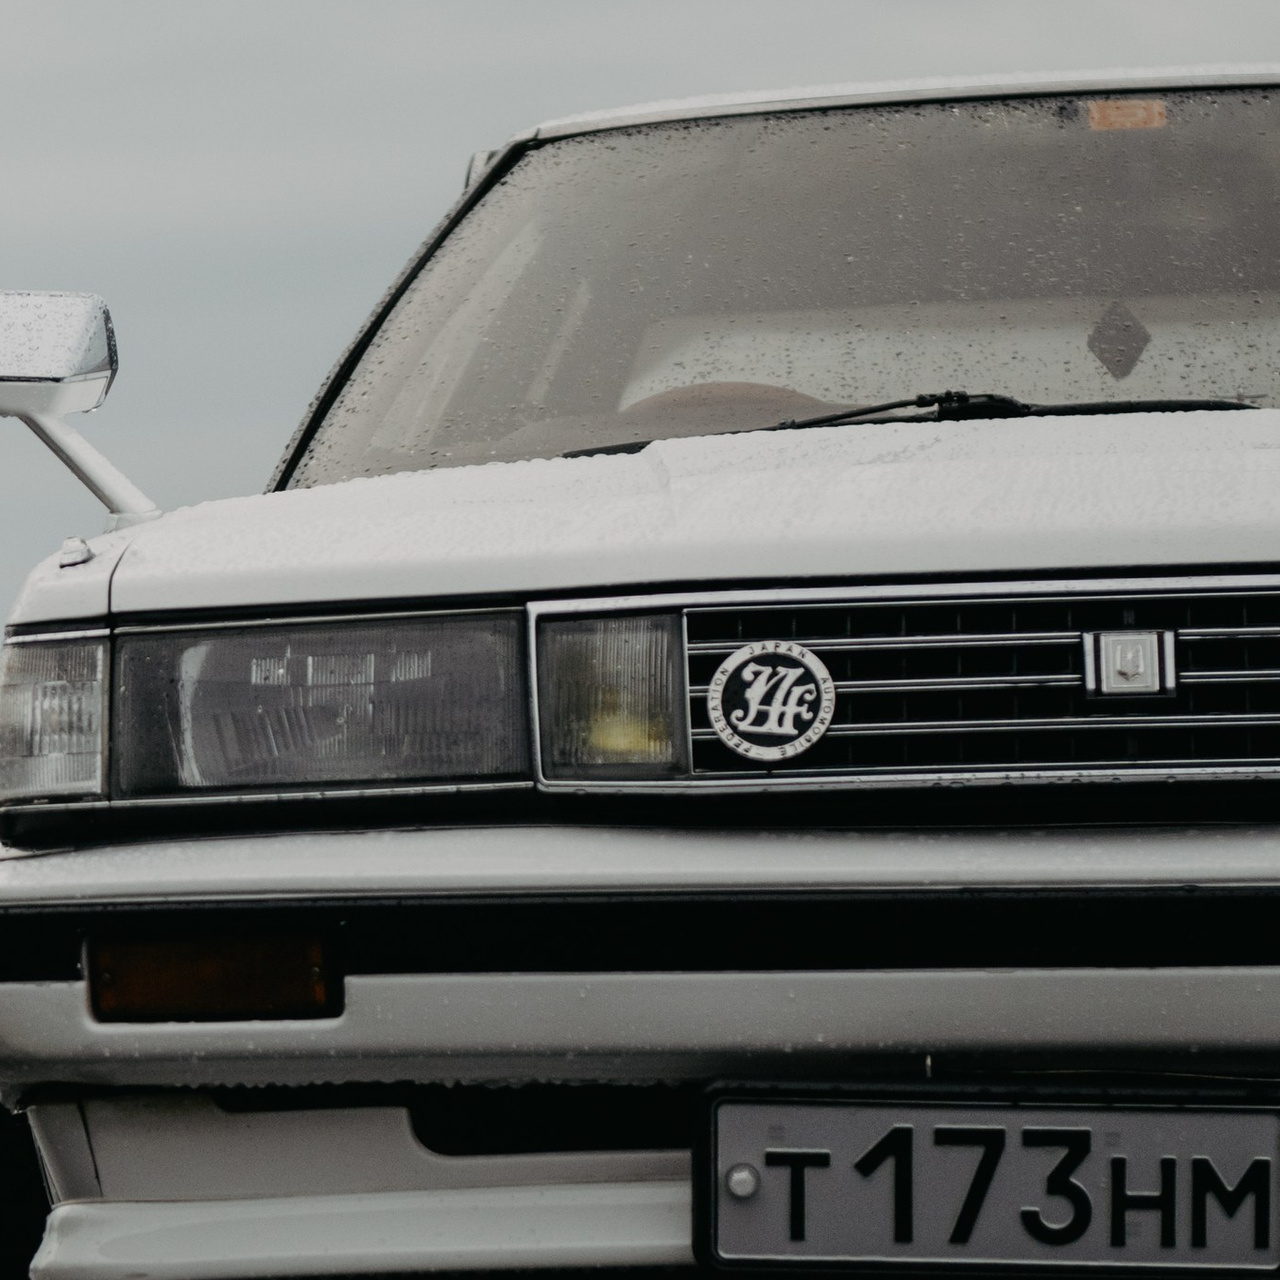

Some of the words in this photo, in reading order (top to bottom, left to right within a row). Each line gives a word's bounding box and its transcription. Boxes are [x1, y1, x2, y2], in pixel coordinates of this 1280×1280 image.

[749, 642, 807, 658] JAPAN
[710, 668, 752, 754] FEDERATION
[779, 677, 834, 756] AUTOMOBILE
